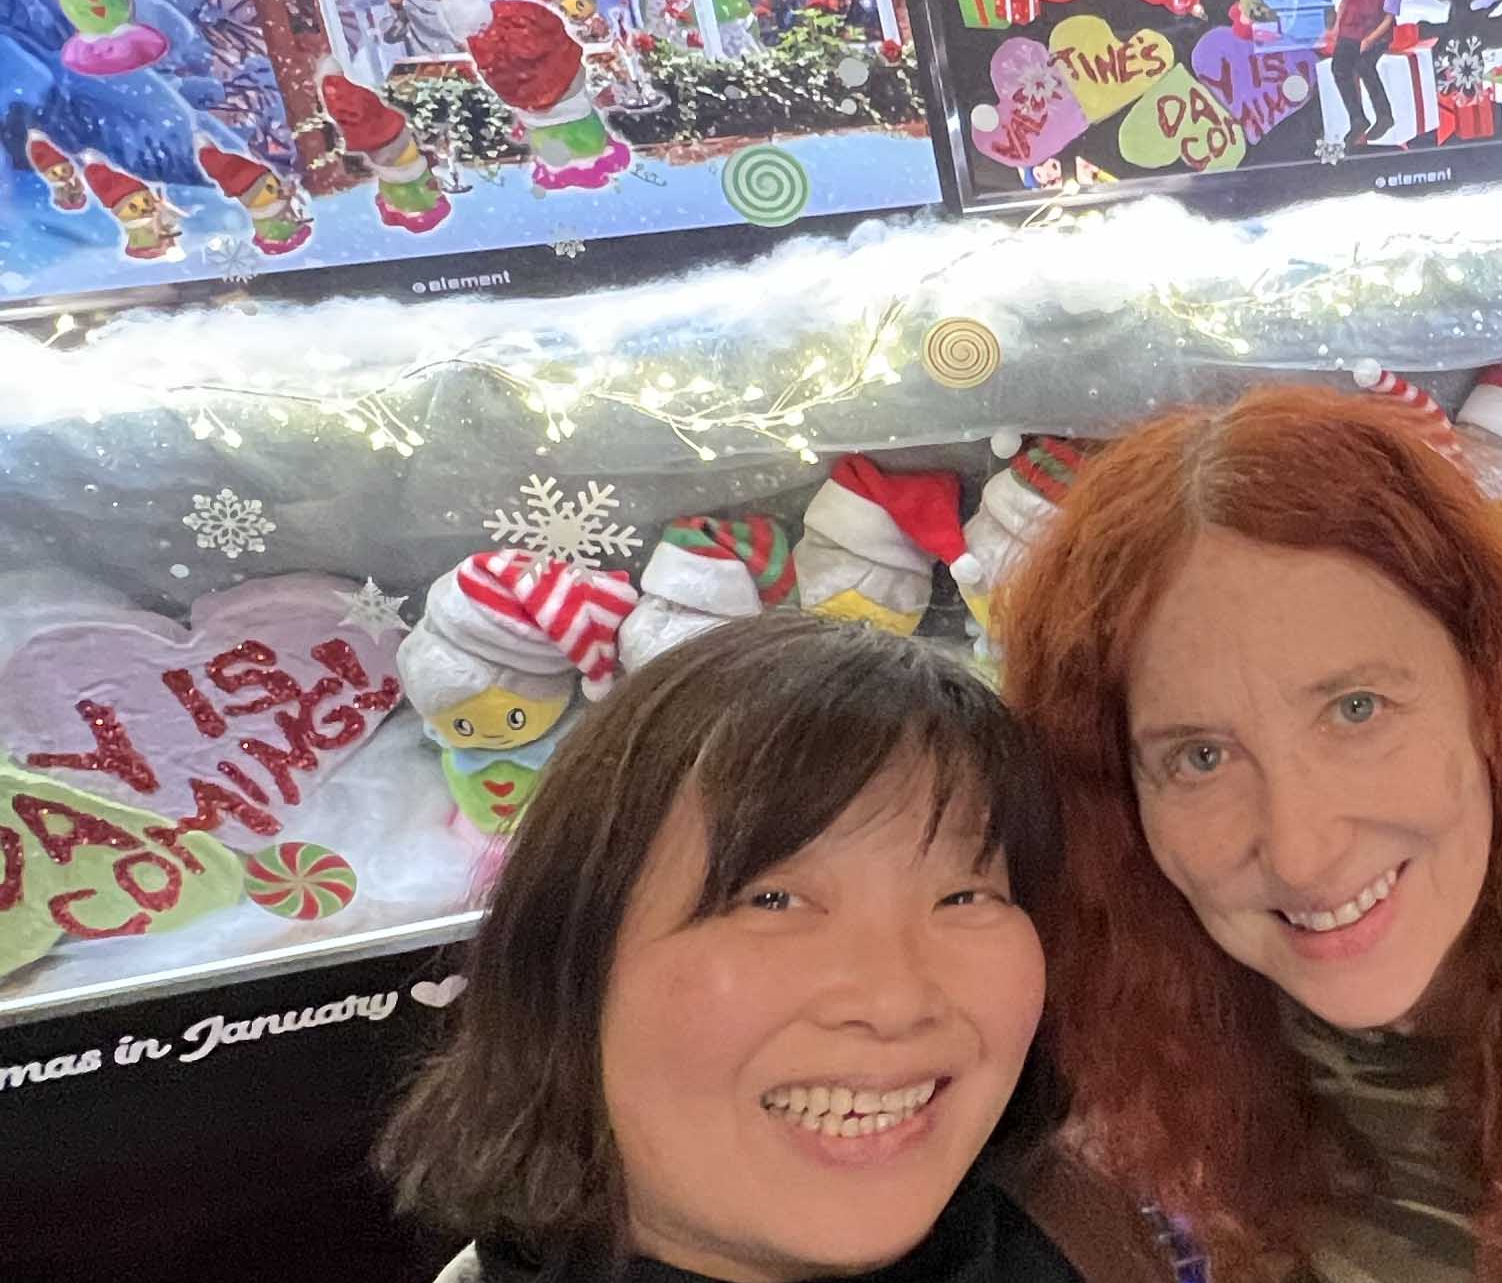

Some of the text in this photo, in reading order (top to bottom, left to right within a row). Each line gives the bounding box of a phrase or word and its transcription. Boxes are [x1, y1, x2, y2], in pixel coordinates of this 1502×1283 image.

[1157, 50, 1289, 138] DAY IS
[1387, 167, 1451, 187] element
[428, 270, 511, 292] element
[0, 639, 304, 911] AY IS
[48, 638, 401, 941] COMING!
[113, 1035, 173, 1065] in
[178, 989, 399, 1063] January
